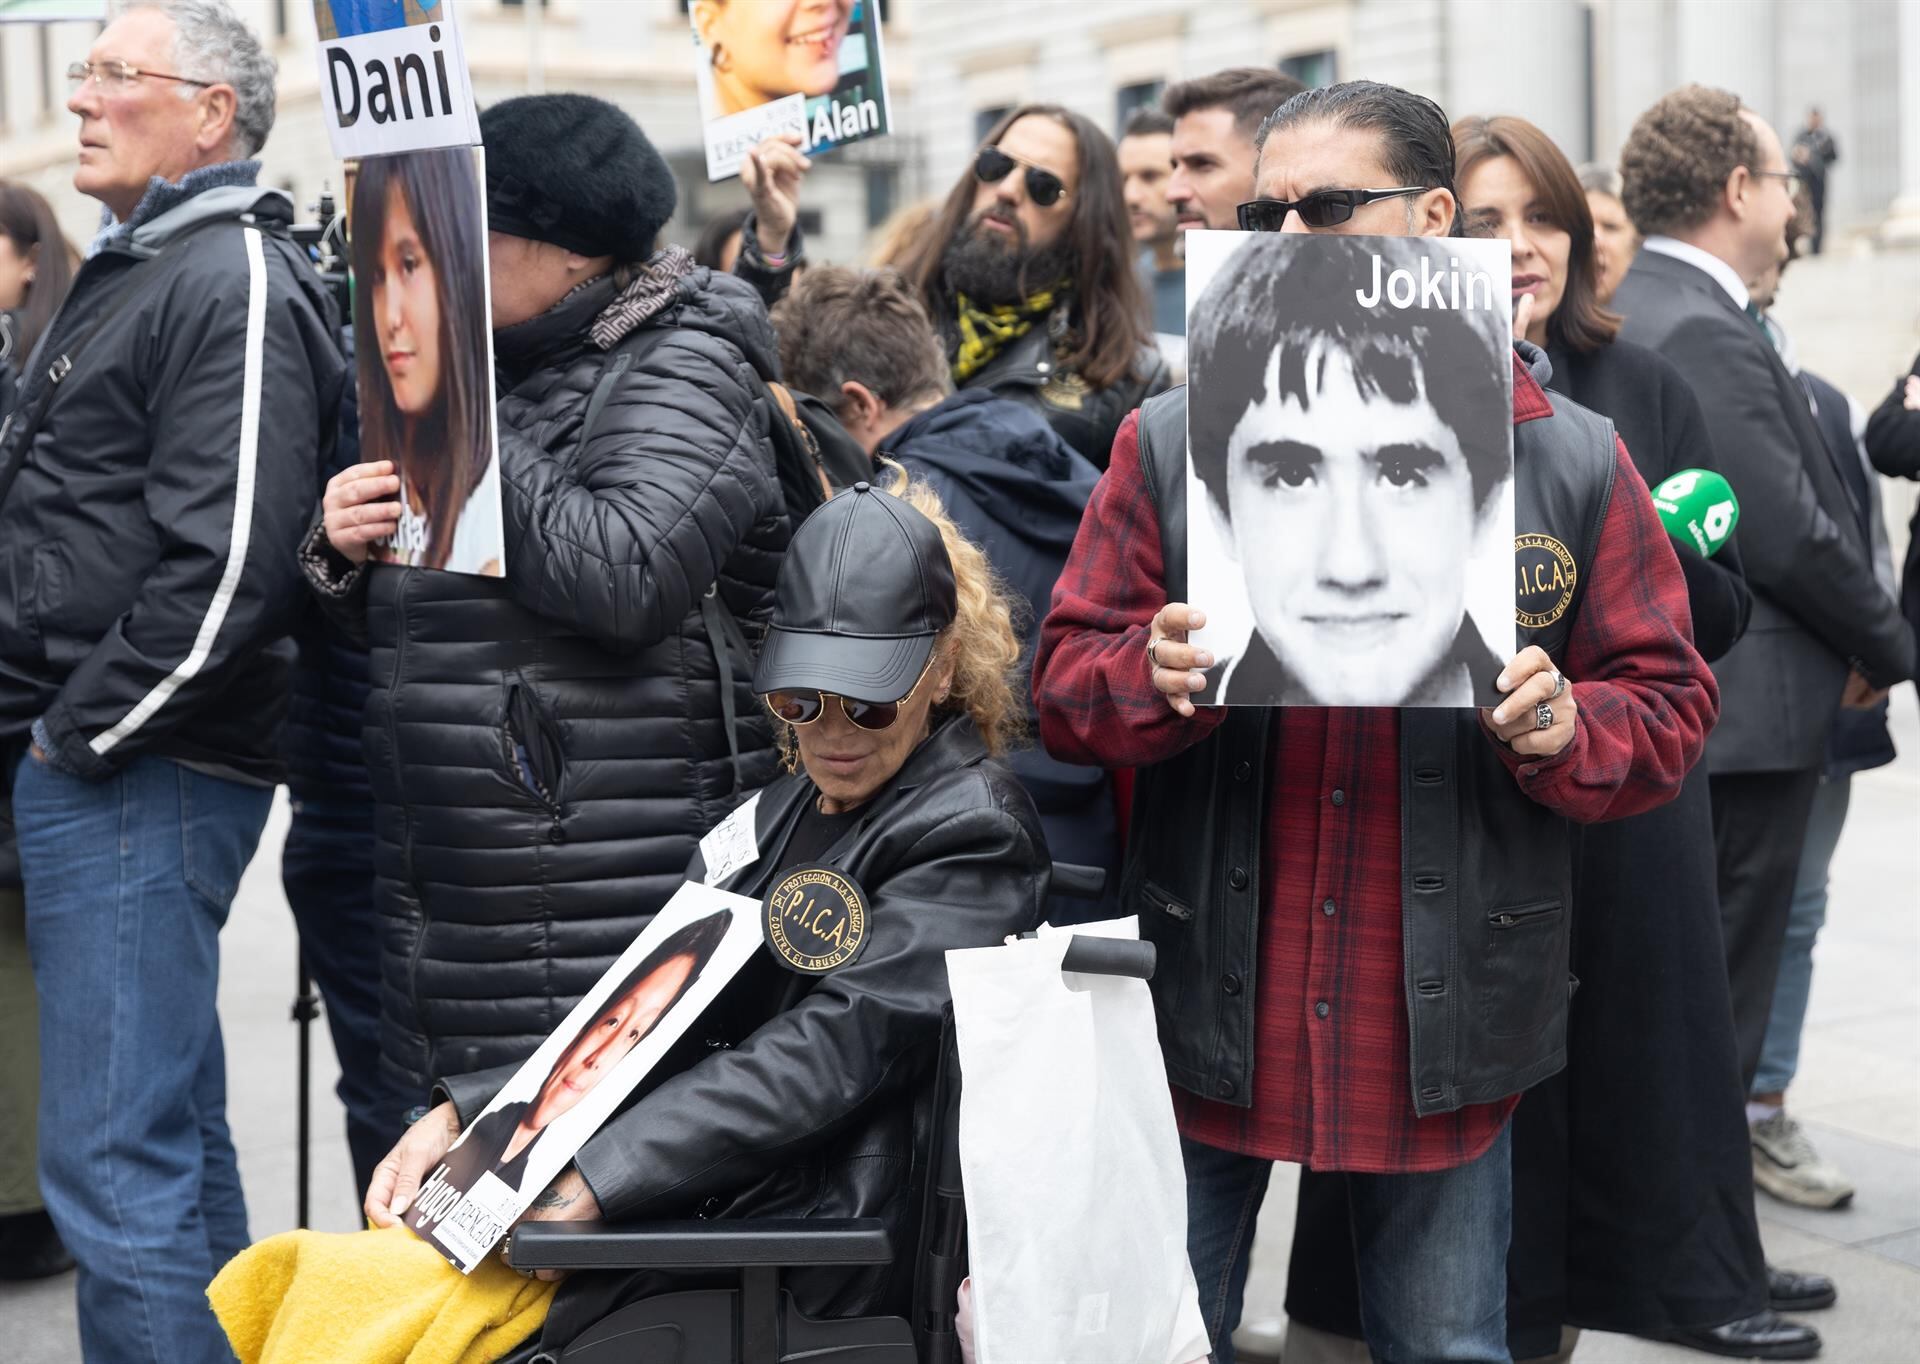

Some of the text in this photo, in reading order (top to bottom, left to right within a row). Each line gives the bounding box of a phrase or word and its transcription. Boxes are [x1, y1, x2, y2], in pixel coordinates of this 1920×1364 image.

[327, 25, 452, 128] Dani
[811, 99, 880, 147] Alan
[1355, 254, 1493, 311] Jokin
[1703, 500, 1735, 543] 6
[1519, 560, 1566, 596] .I.C.A
[1544, 538, 1572, 568] INFANCIA
[1538, 615, 1549, 625] EL
[783, 873, 861, 934] PROTECCION A LA INFANCIA
[771, 916, 842, 968] CONTRA EL ABUSO
[414, 1163, 462, 1229] Hugo
